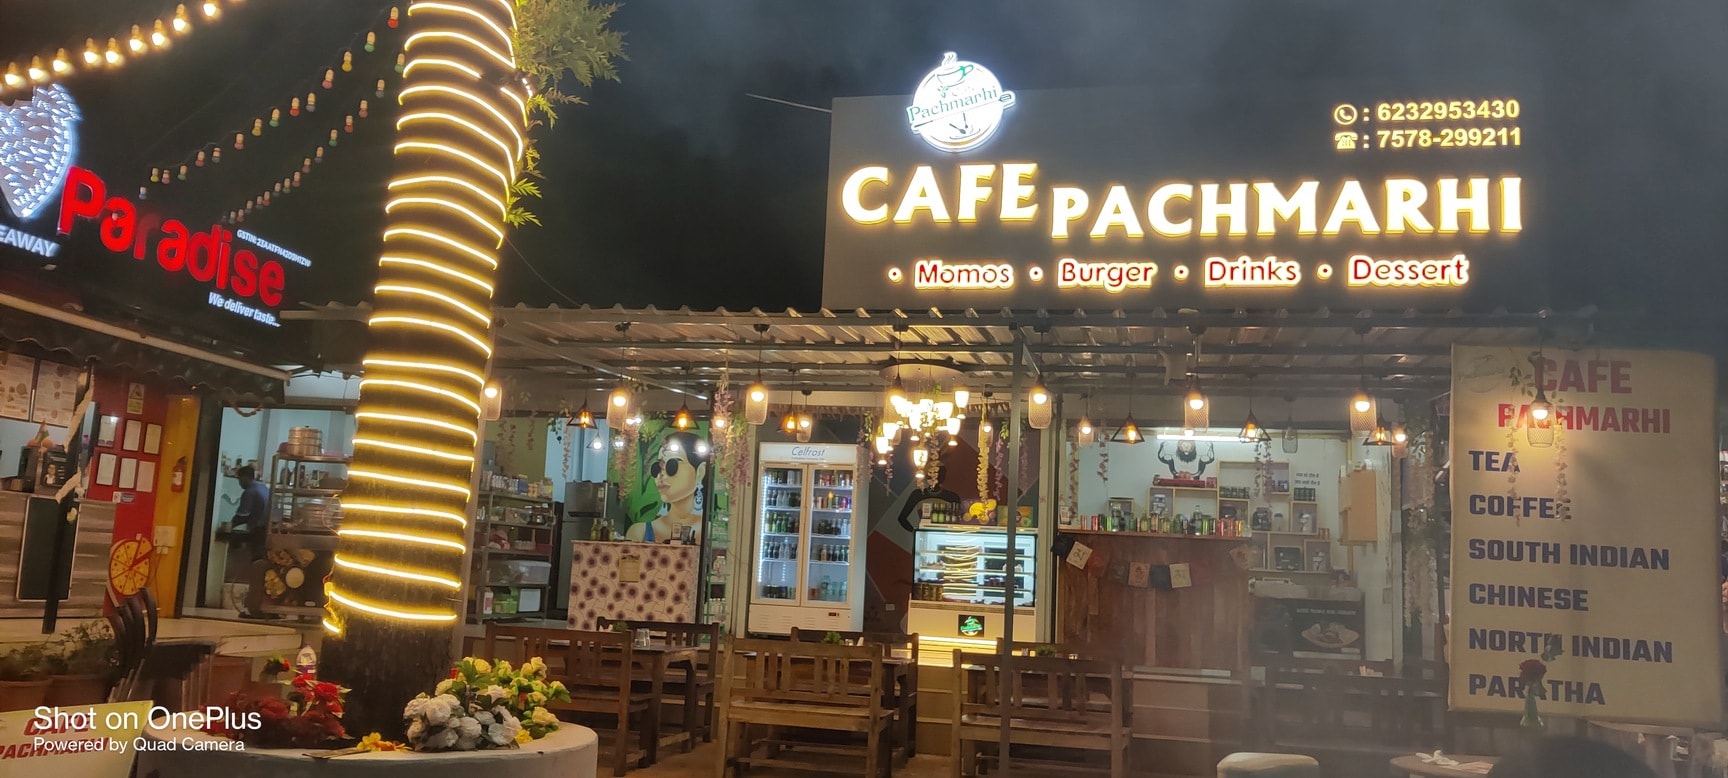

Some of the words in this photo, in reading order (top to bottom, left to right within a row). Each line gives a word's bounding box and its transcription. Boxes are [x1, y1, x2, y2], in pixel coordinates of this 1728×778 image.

[909, 86, 998, 121] Pachmarhi
[1377, 99, 1521, 121] 6232953430
[1377, 127, 1521, 148] 7578-299211
[842, 162, 1039, 225] CAFE
[1051, 177, 1522, 239] PACHMARHI
[58, 165, 285, 307] Paradise
[917, 262, 1012, 285] Momos
[1060, 260, 1154, 288] Burger
[1207, 259, 1298, 282] Drinks
[1352, 258, 1465, 281] Dessert
[208, 292, 225, 307] We
[224, 298, 254, 317] deliver
[1535, 357, 1632, 394] CAFE
[791, 446, 825, 457] Celfrost
[1469, 451, 1520, 473] TEA
[1469, 538, 1560, 564] SOUTH
[1570, 544, 1670, 570] INDIAN
[1469, 583, 1589, 611] CHINESE
[1572, 635, 1673, 663] INDIAN
[1469, 673, 1605, 705] PARTHA
